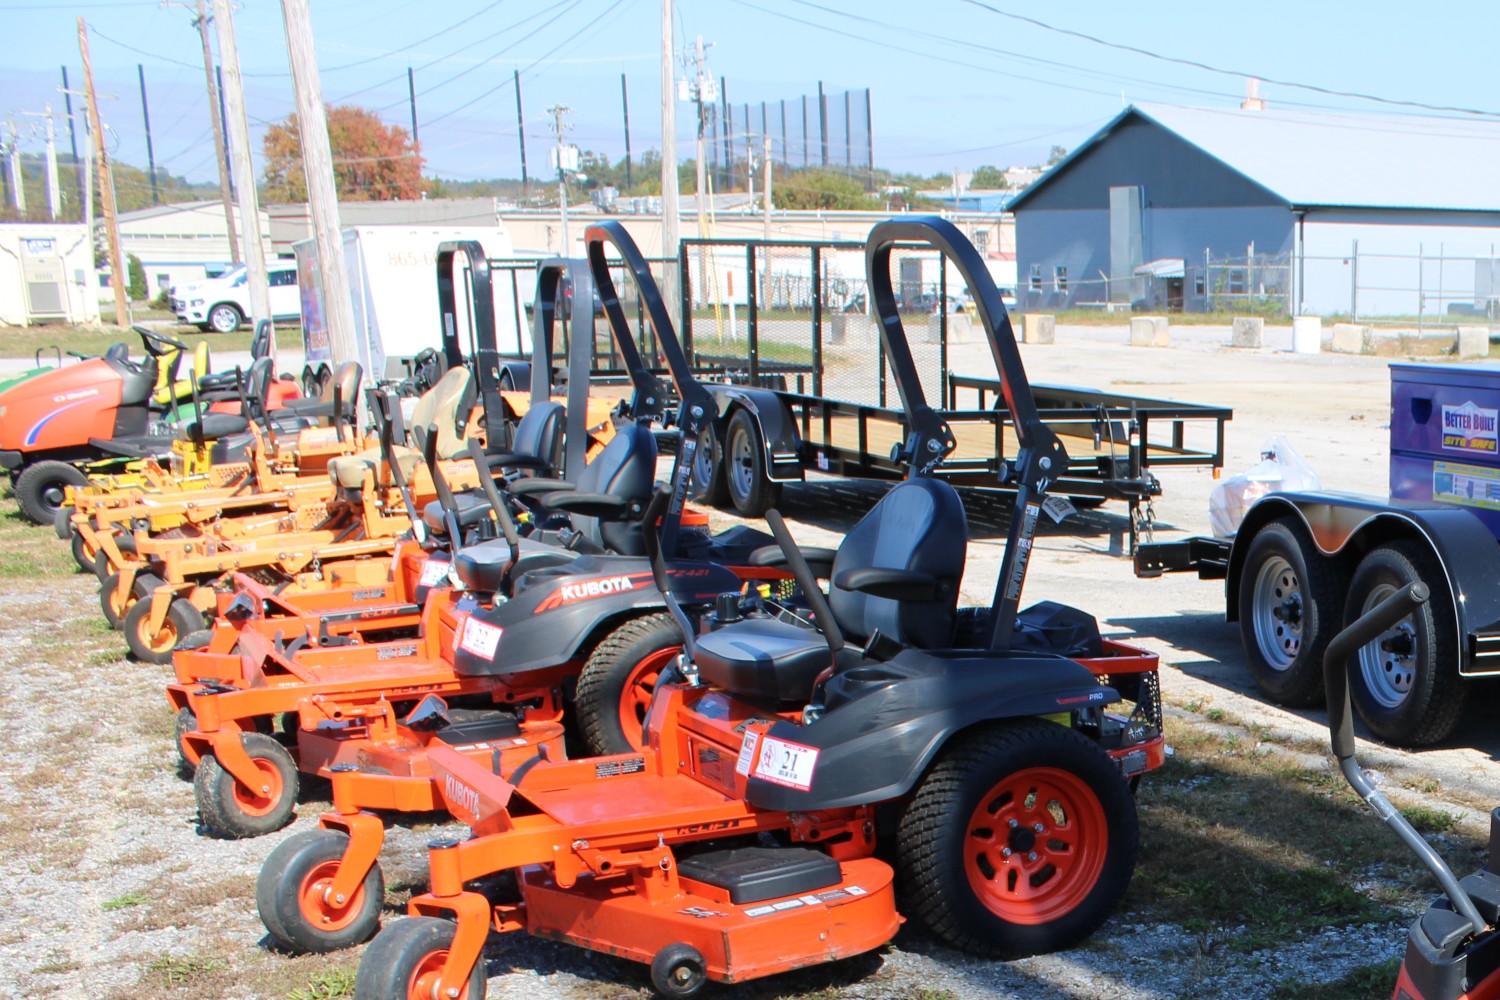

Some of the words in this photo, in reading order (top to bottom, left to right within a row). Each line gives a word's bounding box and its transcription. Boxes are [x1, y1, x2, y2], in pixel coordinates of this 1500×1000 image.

[1444, 411, 1472, 430] BETTER
[1472, 413, 1496, 432] BUILT
[1444, 436, 1467, 447] SITE
[1470, 438, 1496, 450] SAFE
[561, 577, 633, 601] KUBOTA
[1089, 692, 1104, 701] PRO
[782, 750, 798, 772] 21
[445, 773, 480, 818] KUBOTA
